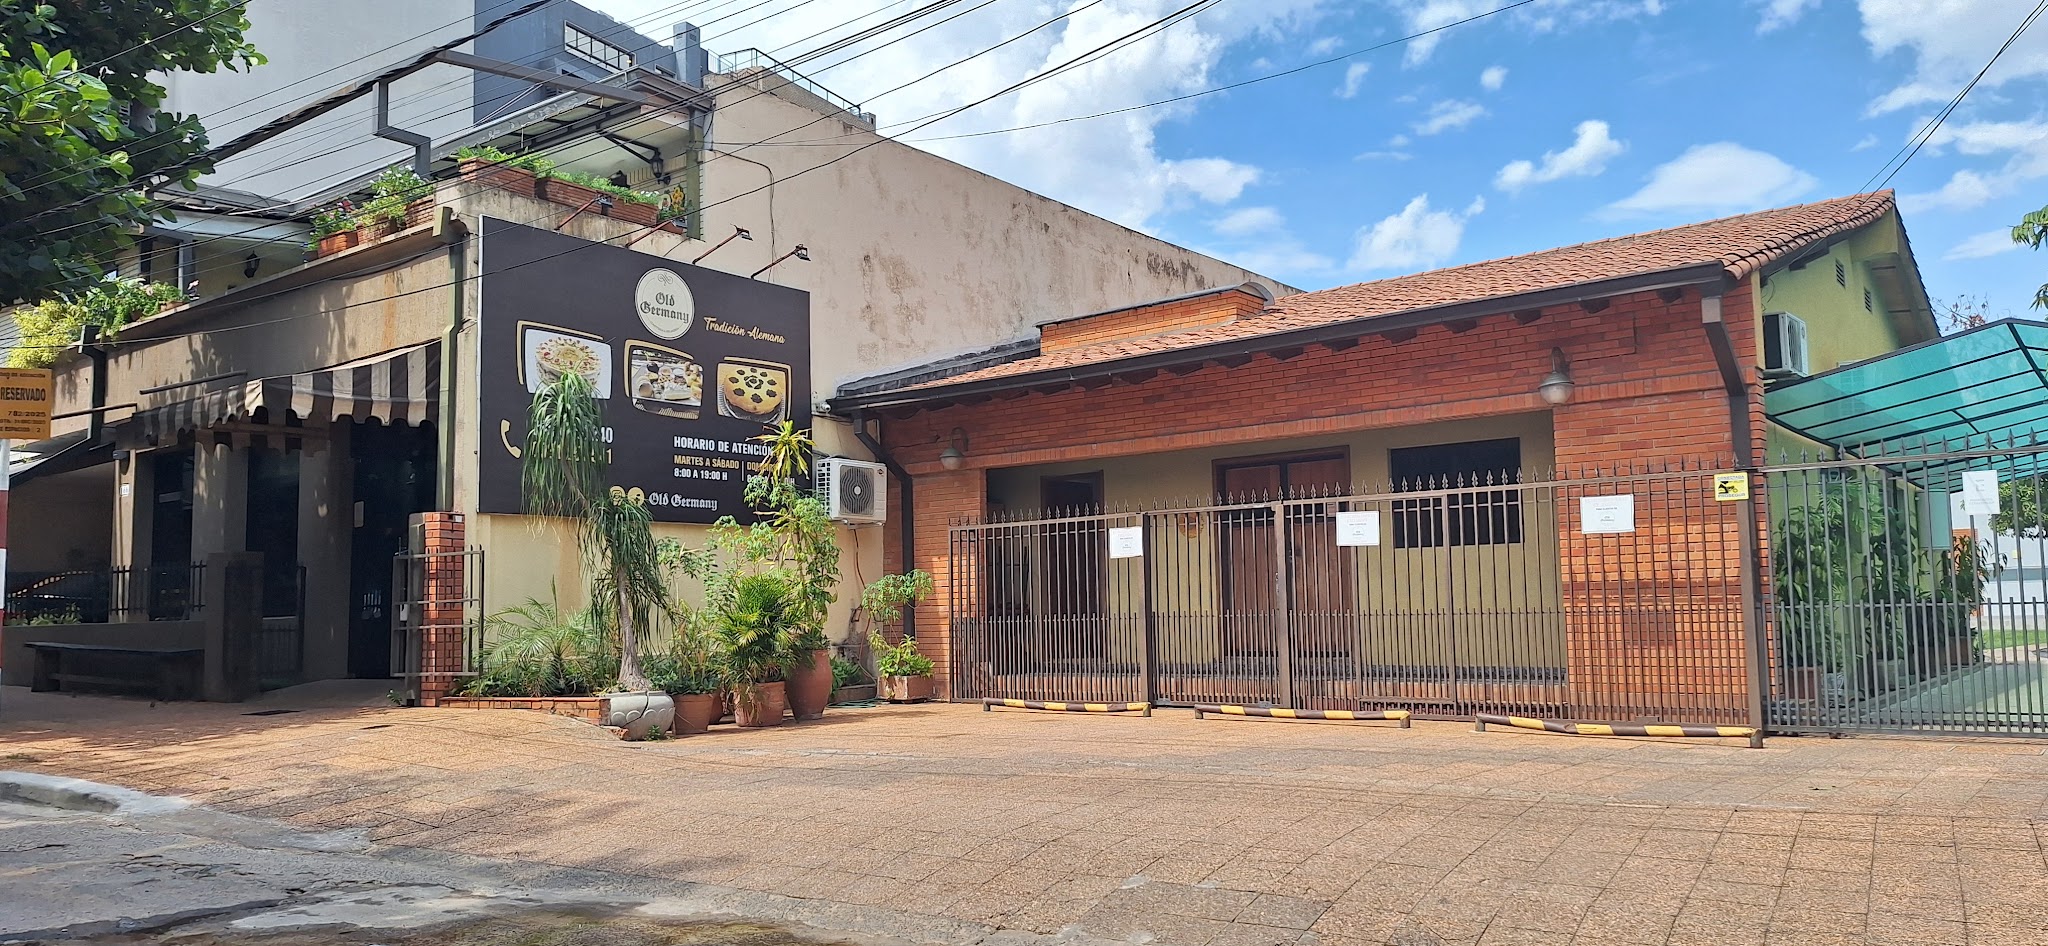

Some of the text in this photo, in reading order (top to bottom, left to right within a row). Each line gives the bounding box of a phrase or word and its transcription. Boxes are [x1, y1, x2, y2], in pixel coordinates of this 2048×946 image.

[656, 292, 675, 306] Old
[640, 301, 689, 323] Germany
[703, 316, 745, 337] Tradición
[747, 326, 786, 344] Alemana
[0, 387, 46, 401] RESERVADO
[673, 436, 773, 456] HORARIO DE ATENCIÓN
[674, 455, 704, 466] MARTES
[705, 457, 711, 467] A
[712, 457, 740, 469] SÁBADO
[674, 467, 728, 481] 8:00 A 19:00 H
[649, 492, 718, 511] Old Germany
